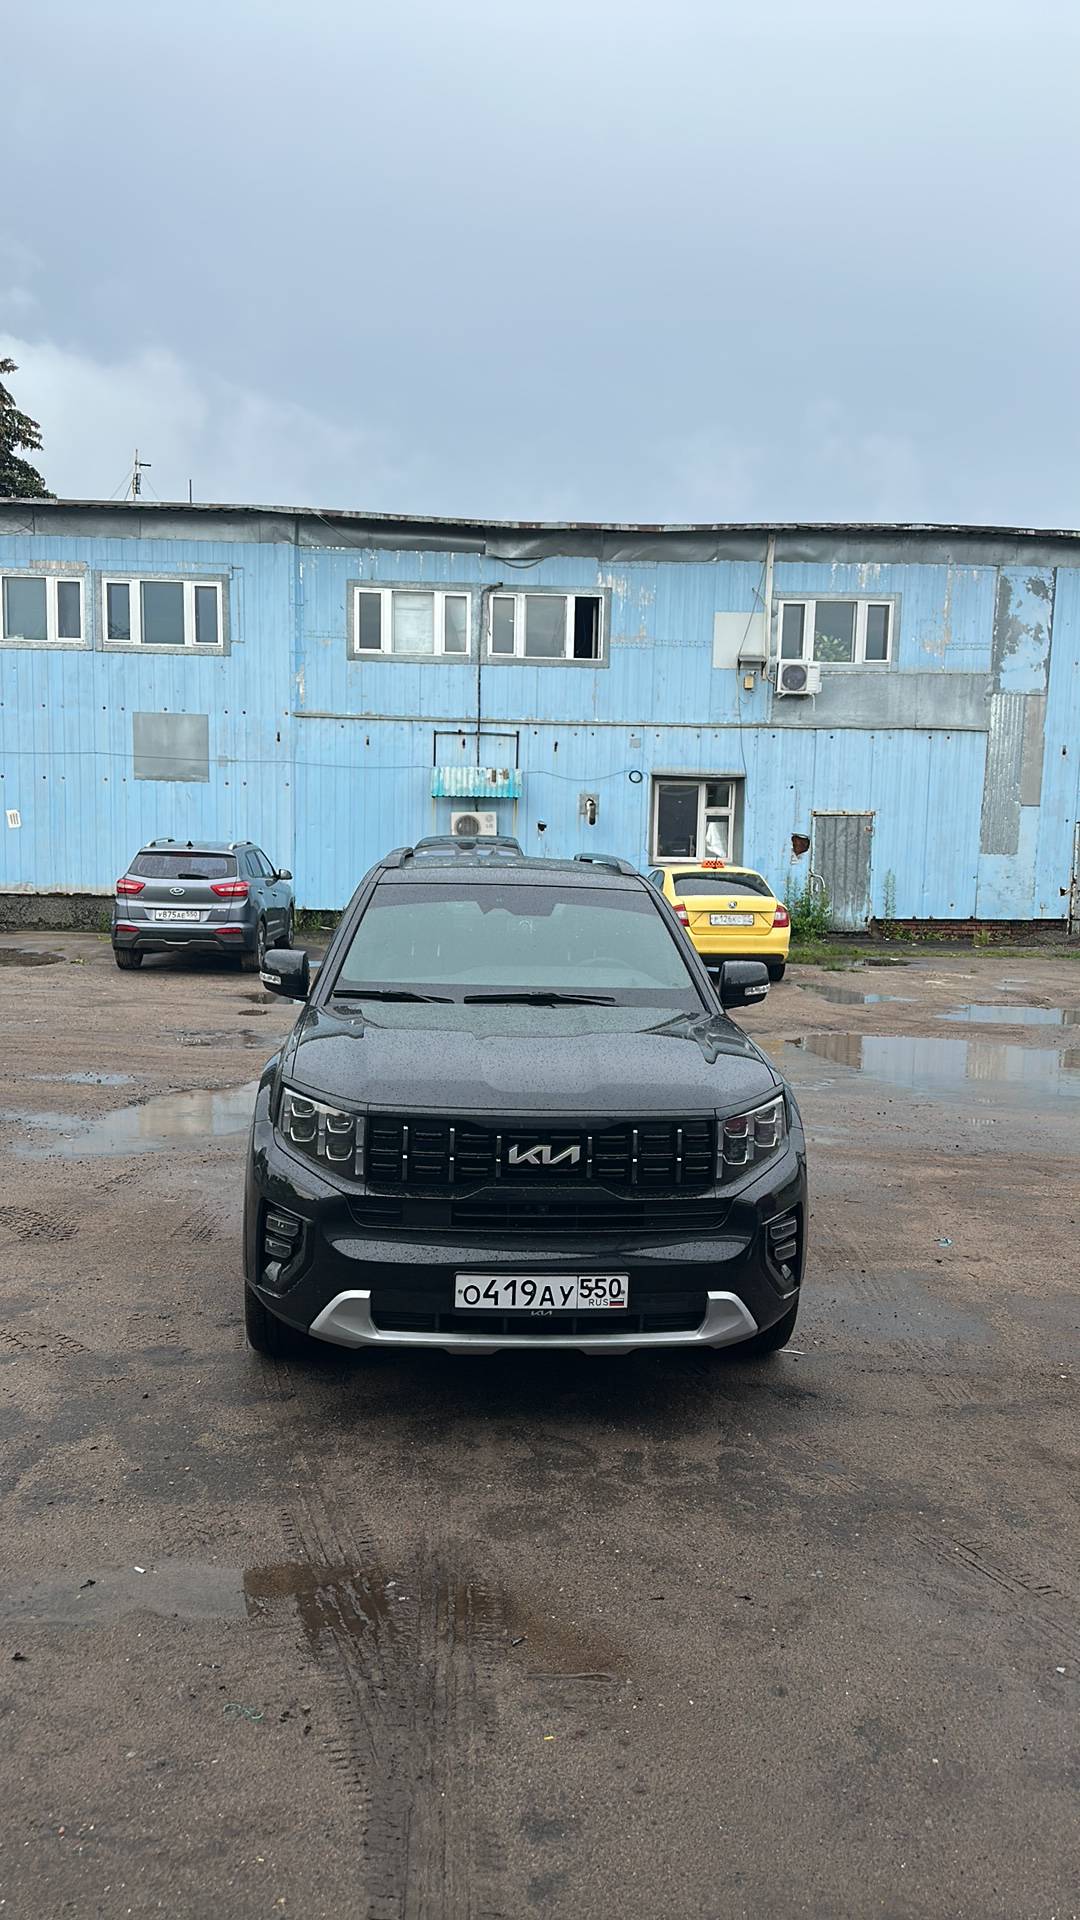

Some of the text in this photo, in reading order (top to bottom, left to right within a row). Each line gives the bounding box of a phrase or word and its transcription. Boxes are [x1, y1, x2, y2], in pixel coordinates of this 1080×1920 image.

[463, 1278, 622, 1306] О419АУ 550
[588, 1298, 609, 1306] RUS
